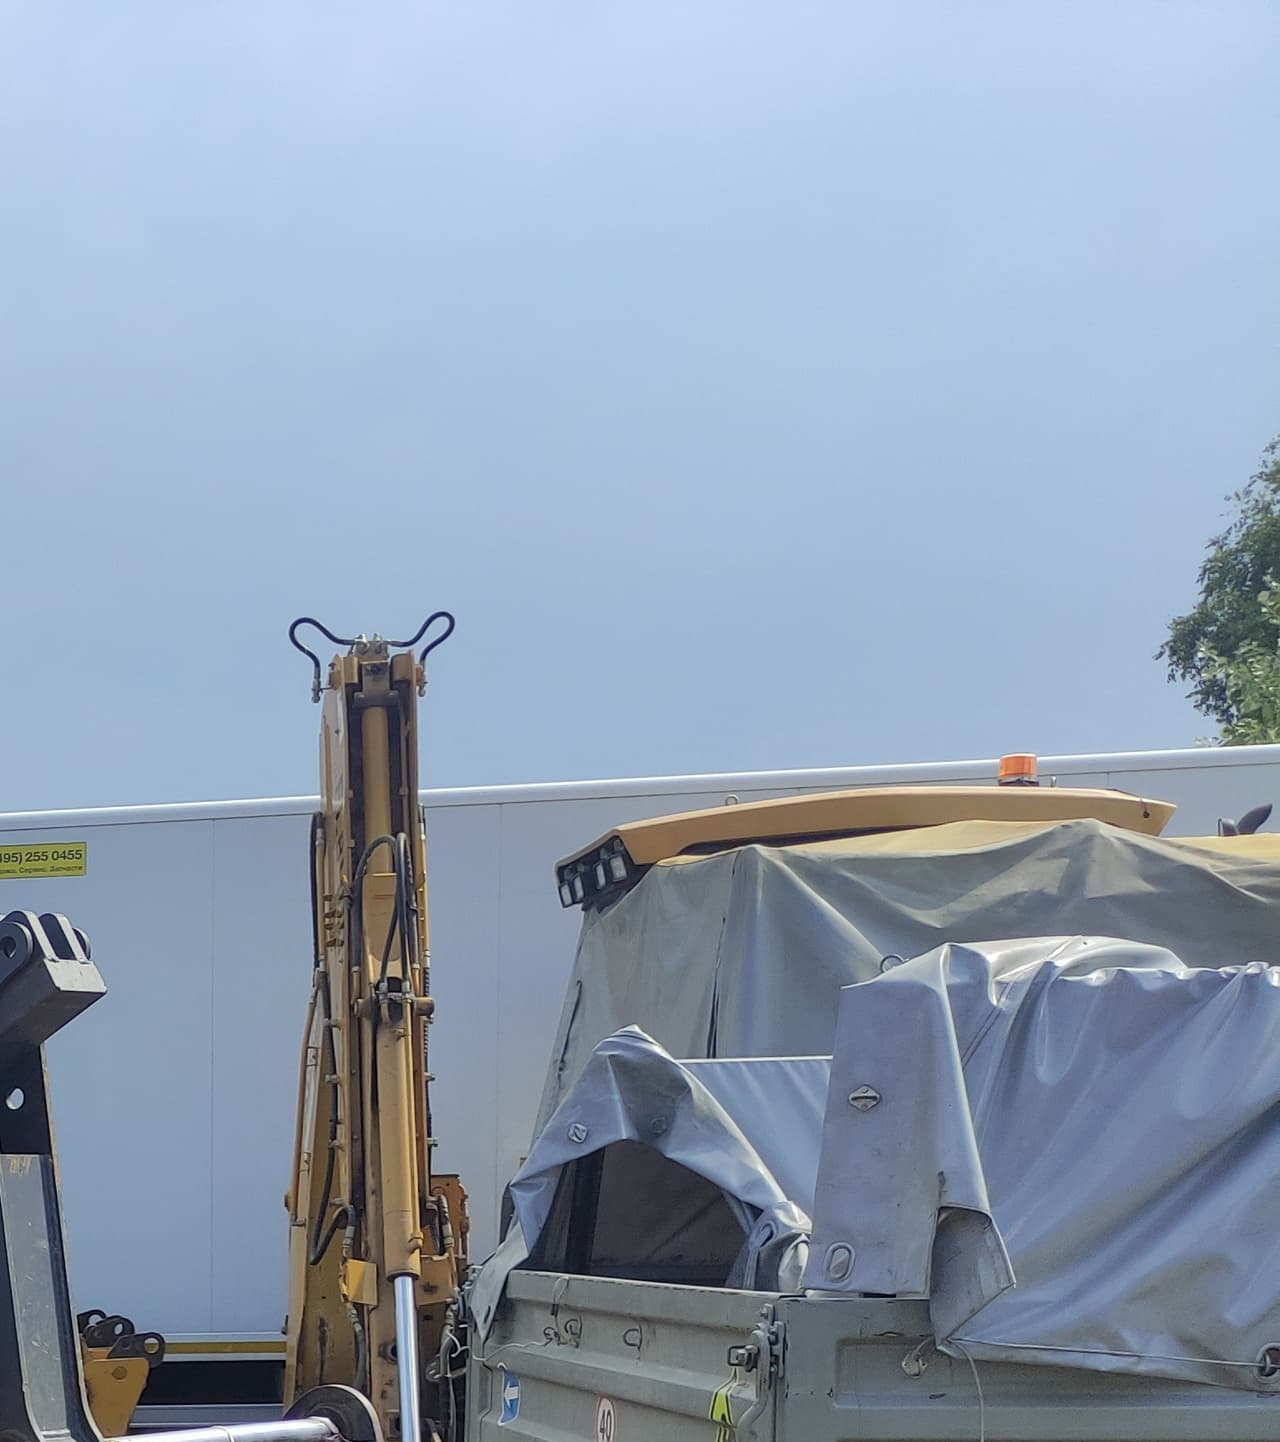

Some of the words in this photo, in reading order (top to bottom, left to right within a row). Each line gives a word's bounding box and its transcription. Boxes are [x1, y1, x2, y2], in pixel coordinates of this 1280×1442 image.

[25, 851, 48, 862] 255
[51, 849, 83, 861] 0455
[599, 1408, 612, 1442] 40
